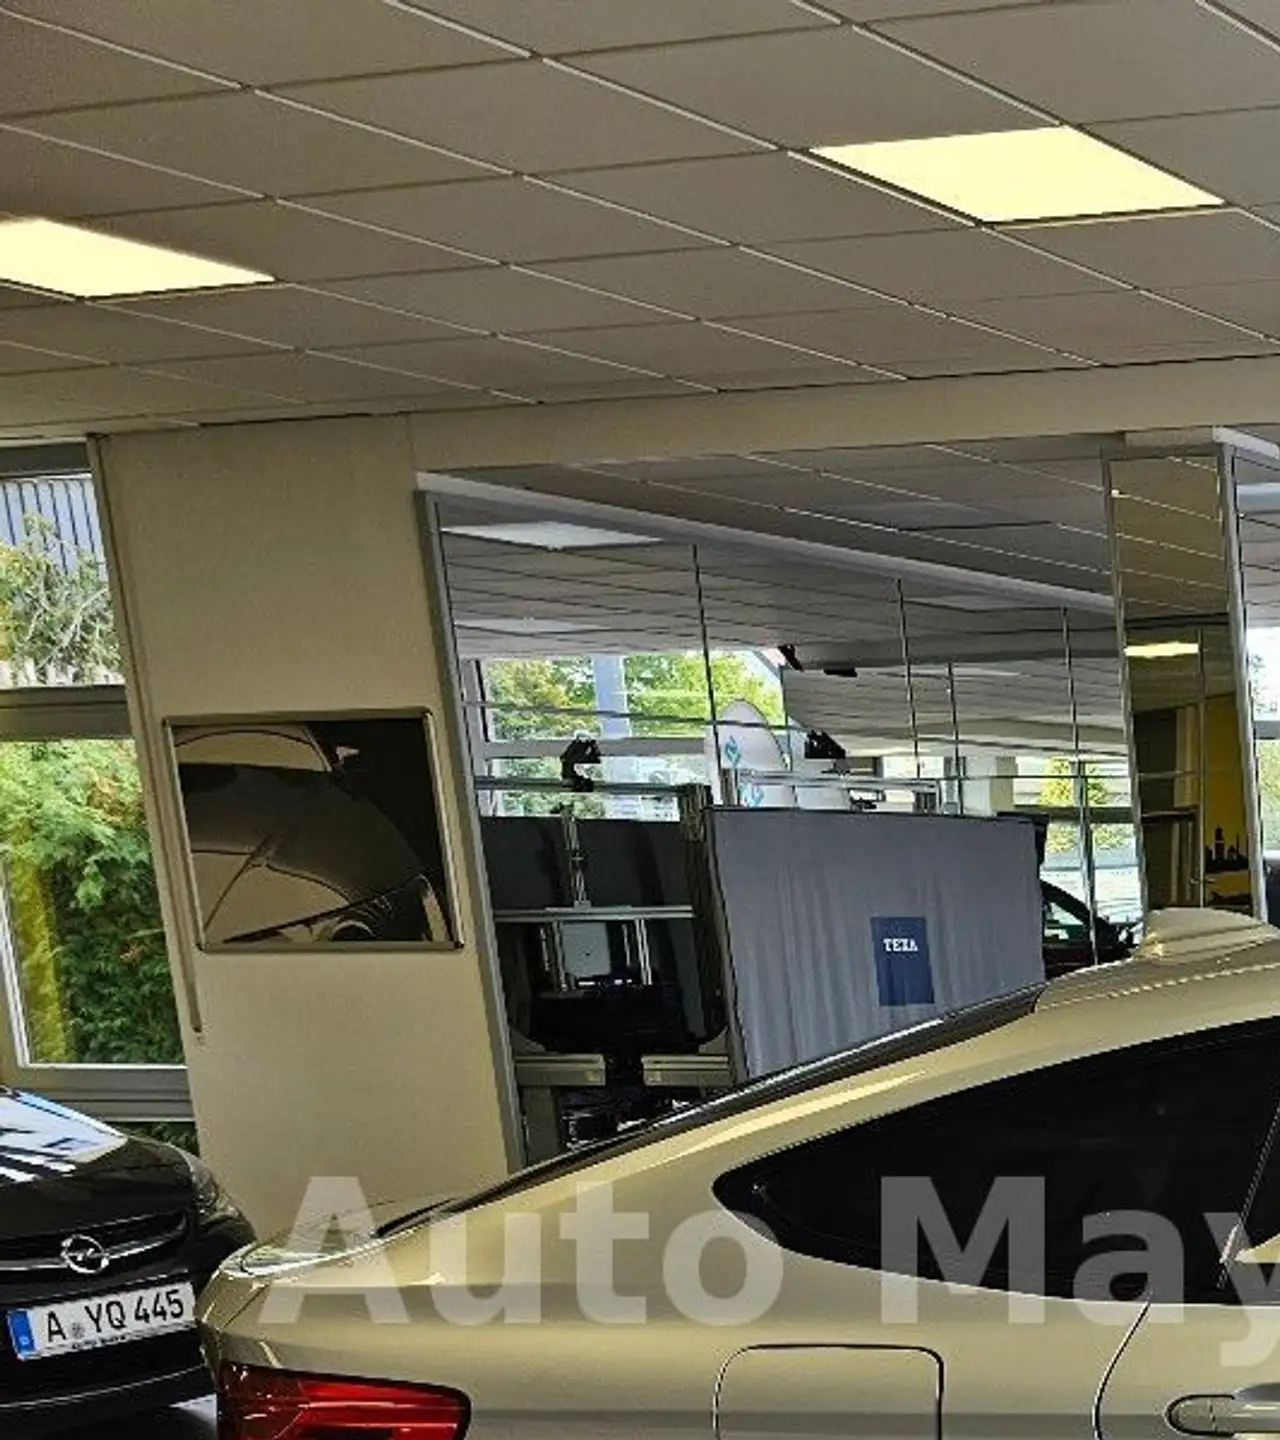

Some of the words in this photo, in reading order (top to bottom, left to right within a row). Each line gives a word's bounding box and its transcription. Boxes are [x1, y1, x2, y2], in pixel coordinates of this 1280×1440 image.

[47, 1310, 67, 1343] A
[84, 1300, 127, 1333] YQ
[134, 1288, 185, 1324] 445
